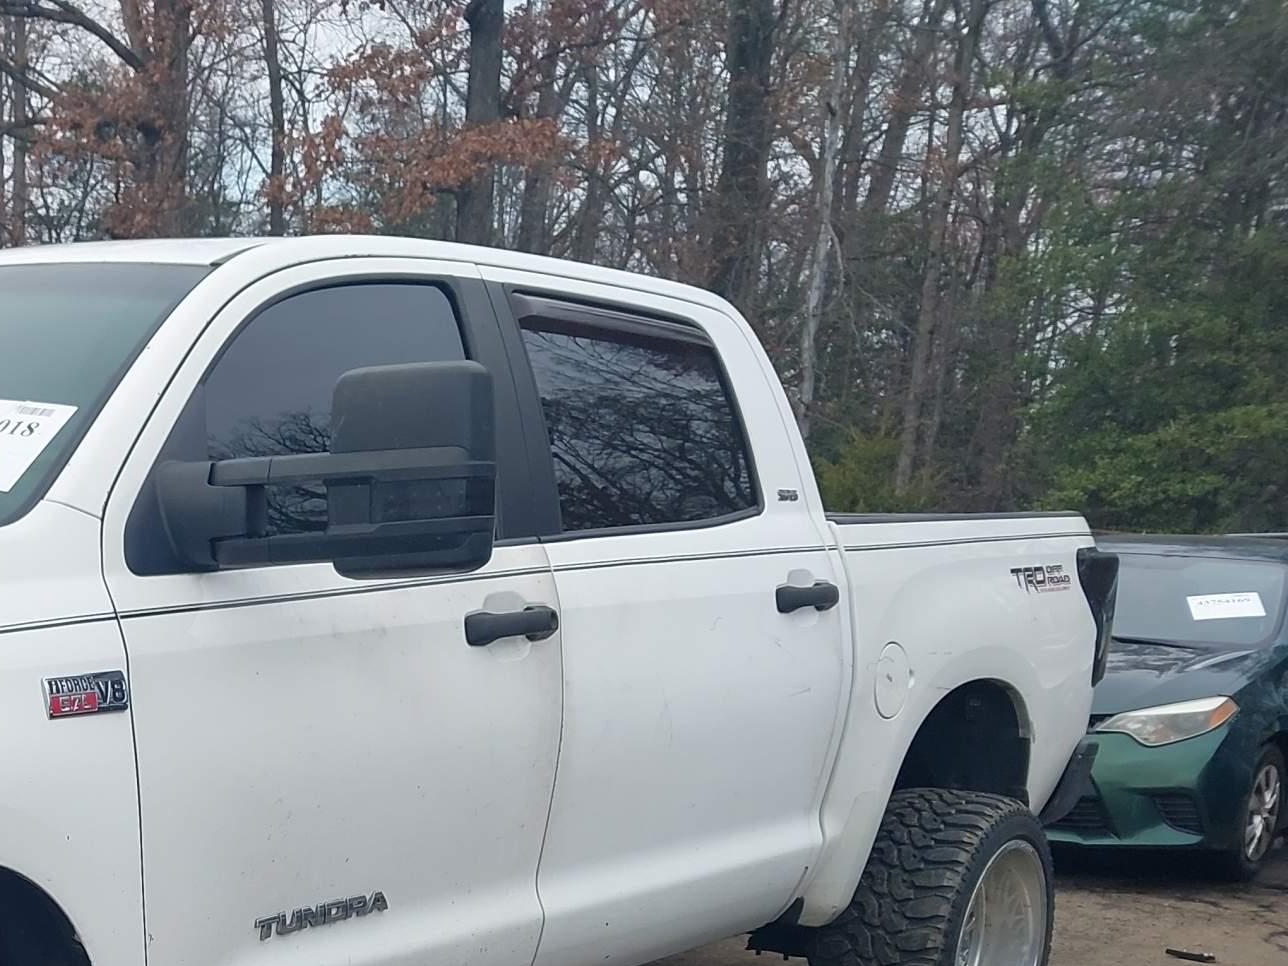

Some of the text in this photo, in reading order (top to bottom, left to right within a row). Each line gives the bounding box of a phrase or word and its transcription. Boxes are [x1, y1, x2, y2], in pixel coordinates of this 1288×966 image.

[1010, 565, 1047, 594] TRD
[1047, 574, 1071, 584] ROAD
[96, 679, 127, 705] V8
[254, 890, 388, 941] TUNDRA
